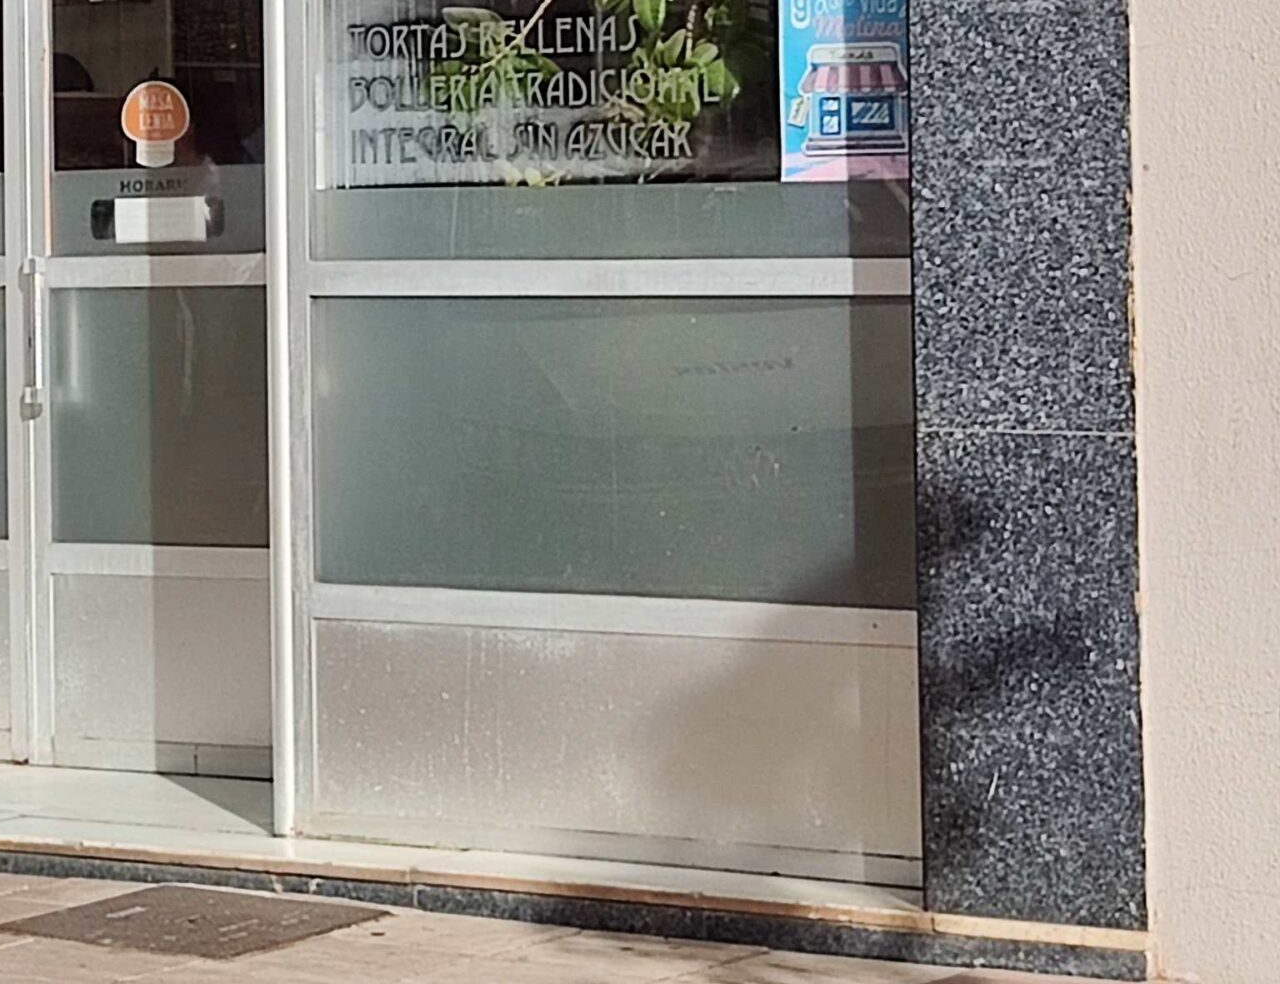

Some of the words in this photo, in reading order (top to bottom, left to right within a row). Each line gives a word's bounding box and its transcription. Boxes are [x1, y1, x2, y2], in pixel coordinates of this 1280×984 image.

[347, 22, 470, 59] TORTAS
[479, 15, 639, 58] RELLENAS
[351, 124, 498, 164] INTEGRAL
[507, 120, 557, 161] SIN
